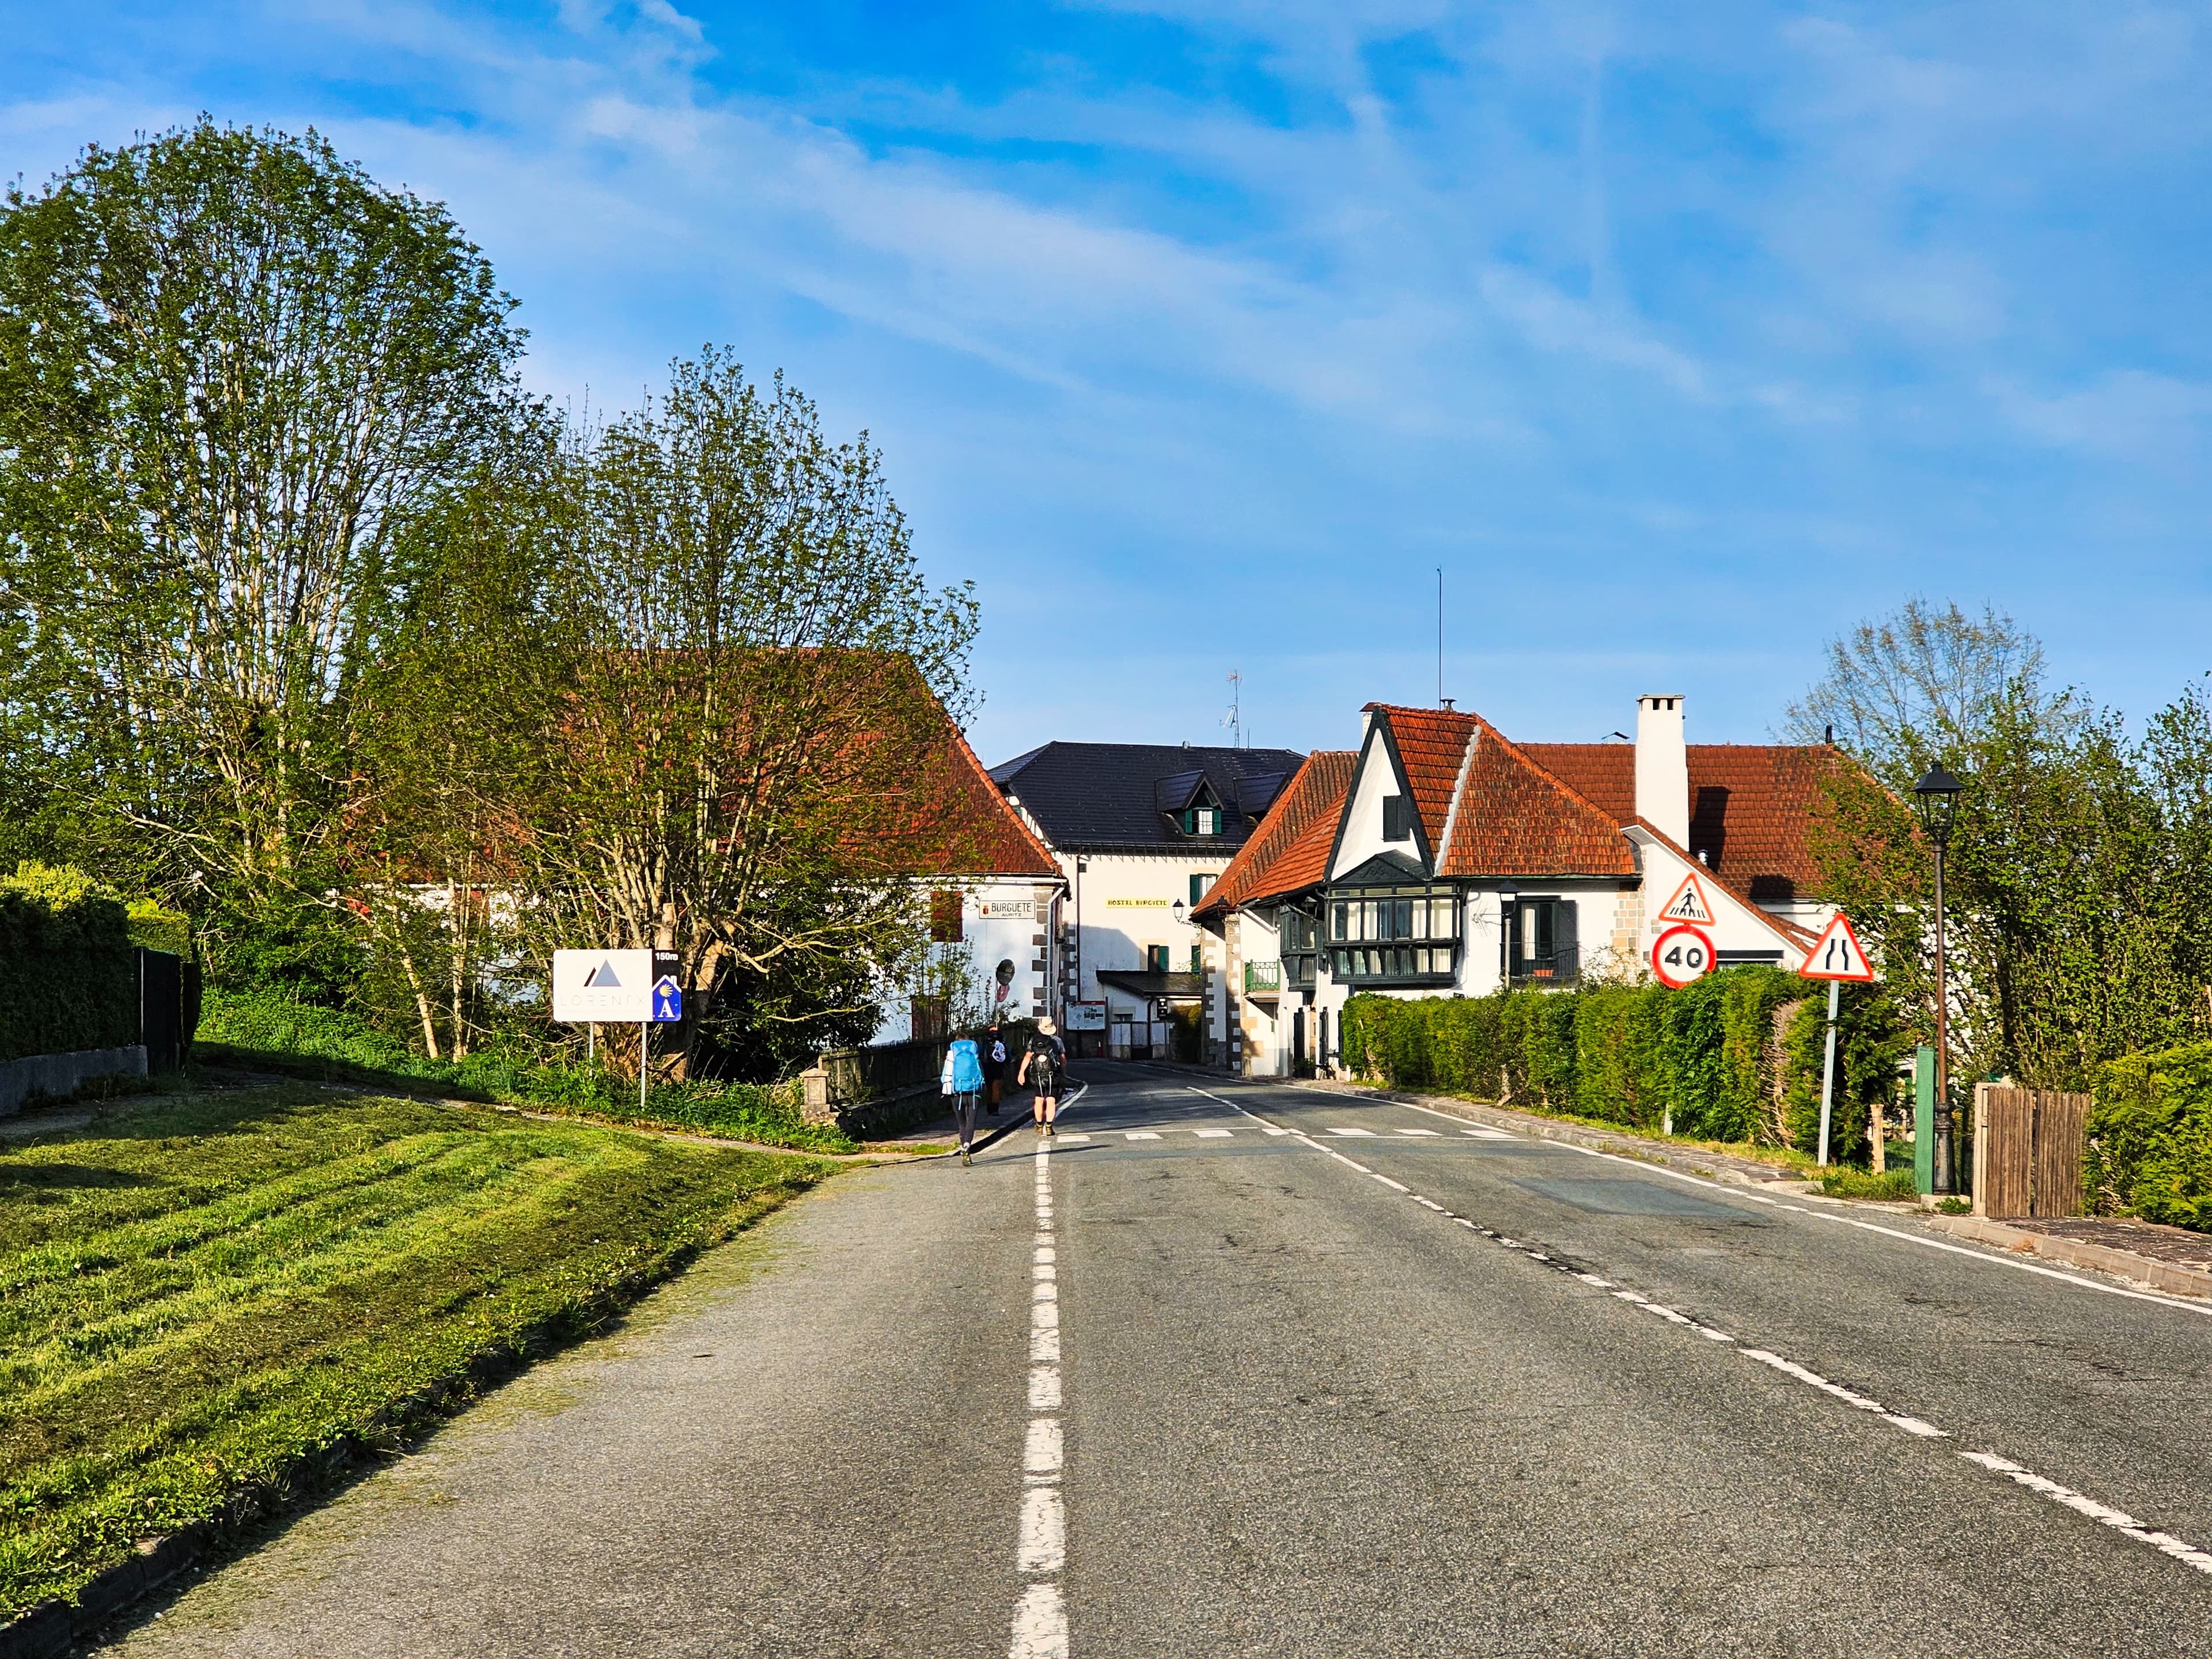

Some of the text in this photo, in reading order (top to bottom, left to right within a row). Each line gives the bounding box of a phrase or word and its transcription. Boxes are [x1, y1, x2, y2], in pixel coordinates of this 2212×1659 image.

[992, 903, 1032, 912] BURGUETE
[655, 952, 679, 960] 150m
[1665, 946, 1702, 968] 40
[658, 999, 675, 1017] A
